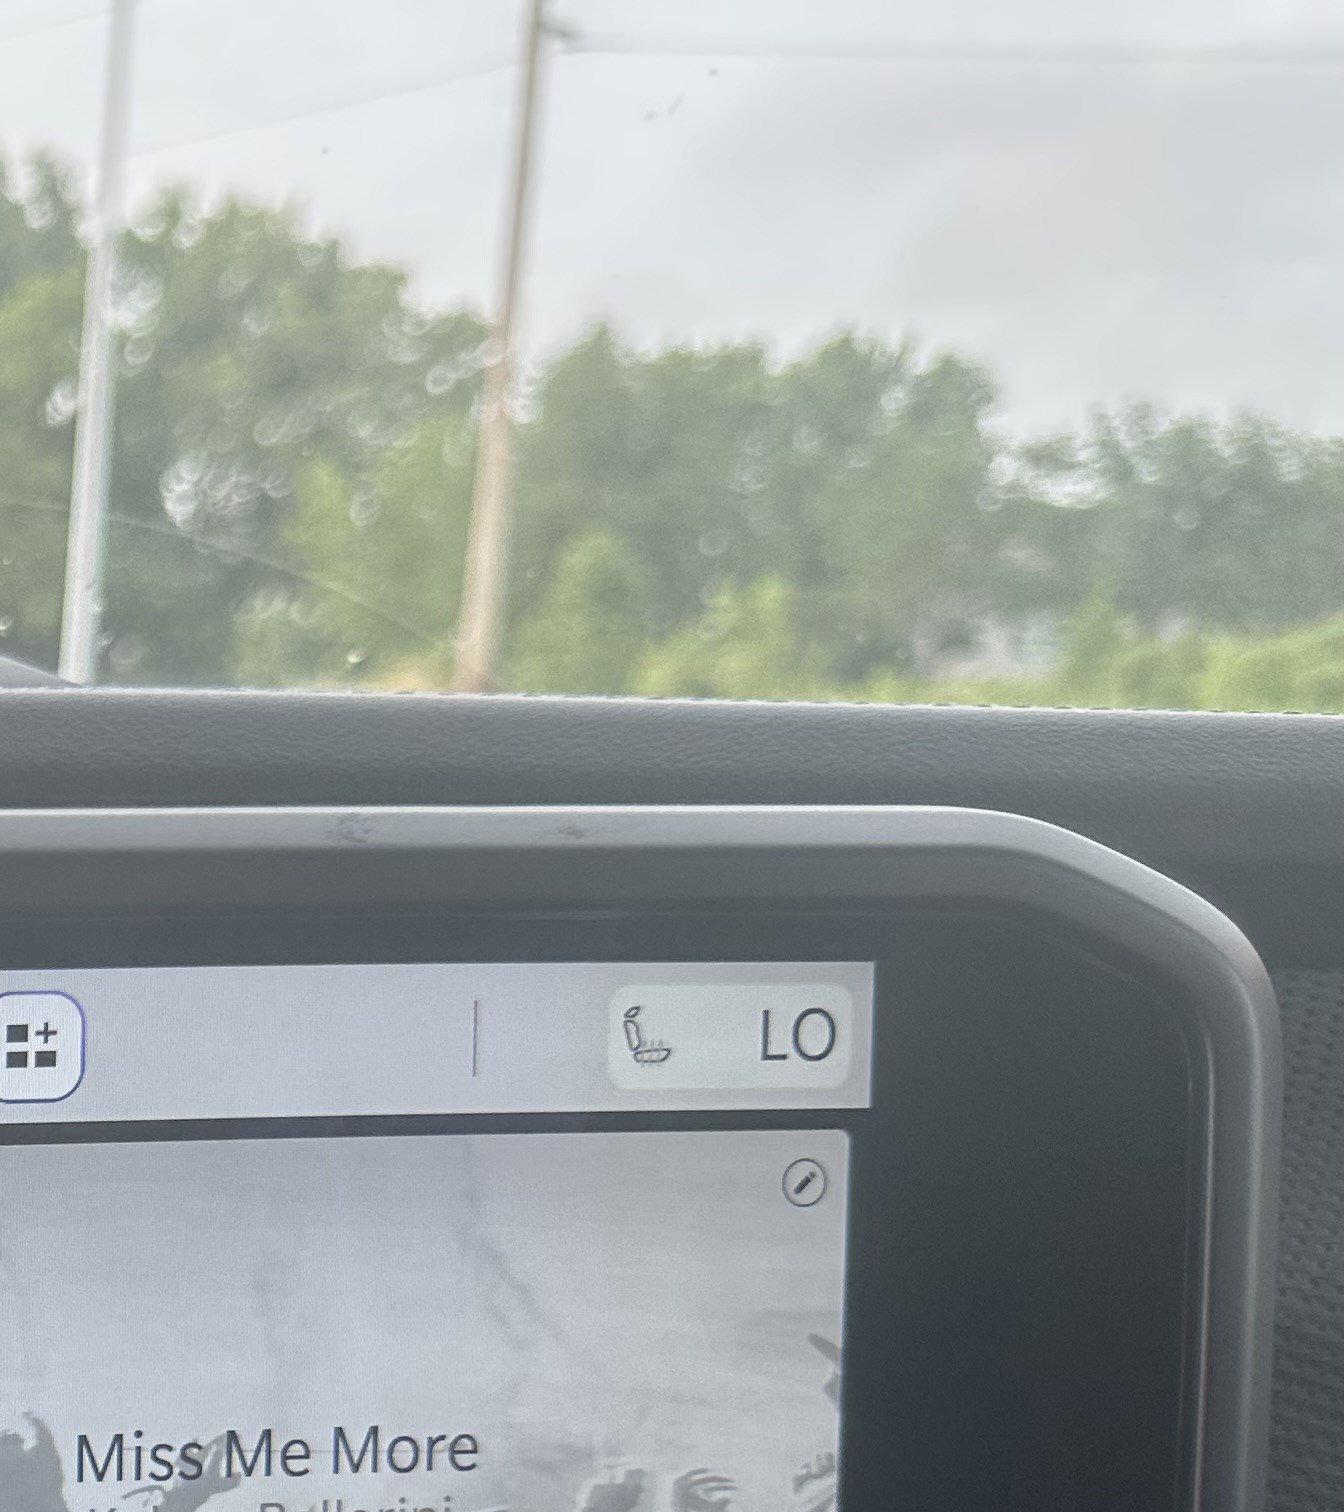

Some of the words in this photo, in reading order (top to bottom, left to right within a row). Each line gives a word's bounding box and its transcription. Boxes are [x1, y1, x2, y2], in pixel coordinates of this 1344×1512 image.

[760, 1007, 836, 1062] LO
[75, 1429, 205, 1484] Miss
[224, 1427, 311, 1479] Me
[331, 1424, 480, 1476] More
